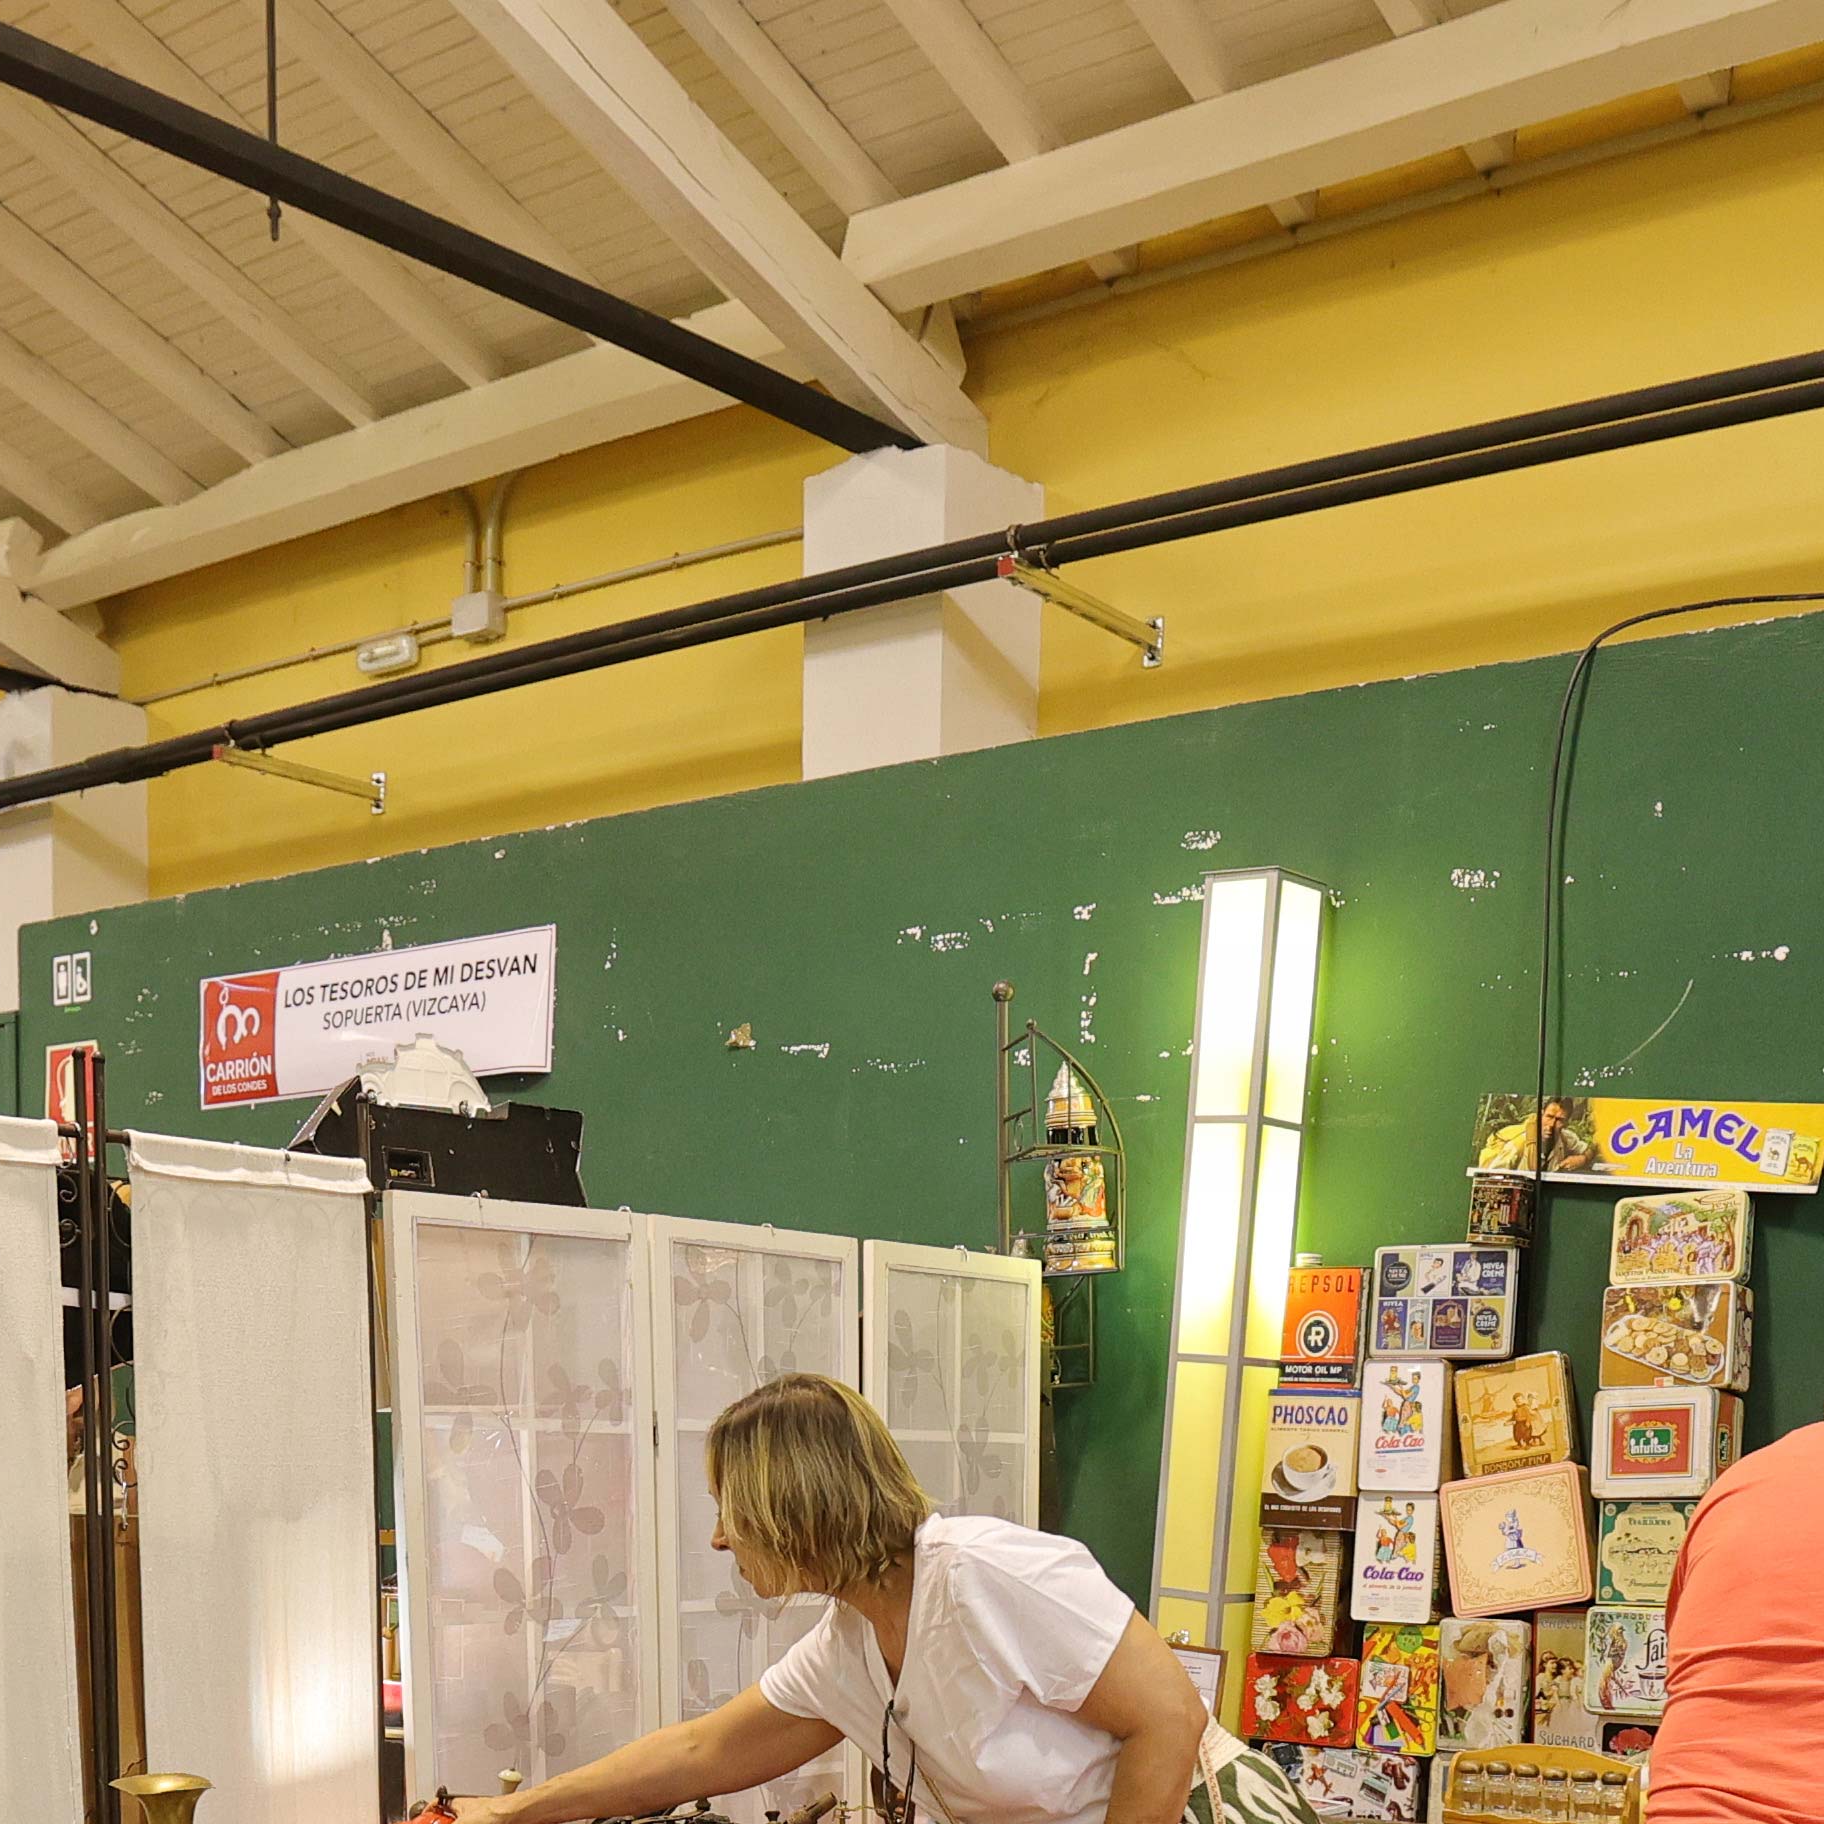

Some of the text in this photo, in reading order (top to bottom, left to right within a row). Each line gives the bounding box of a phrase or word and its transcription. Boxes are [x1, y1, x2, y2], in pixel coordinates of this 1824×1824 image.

[283, 953, 537, 1009] LOS TESOROS DE MI DESVAN
[322, 990, 488, 1032] SOPUERTA (VIZCAYA)
[206, 1051, 272, 1083] CARRIÓN
[212, 1079, 268, 1096] DE LOS CONDES
[1610, 1107, 1763, 1164] CAMEL
[1673, 1142, 1694, 1161] La
[1644, 1158, 1719, 1177] Aventura
[1482, 1262, 1505, 1271] NIVEA
[1289, 1274, 1355, 1294] REPSOL
[1285, 1365, 1343, 1374] MOTOR OIL MP
[1271, 1404, 1348, 1426] PHOSCAO
[1363, 1565, 1425, 1582] Cola Cao
[1539, 1730, 1596, 1748] SUCHARD
